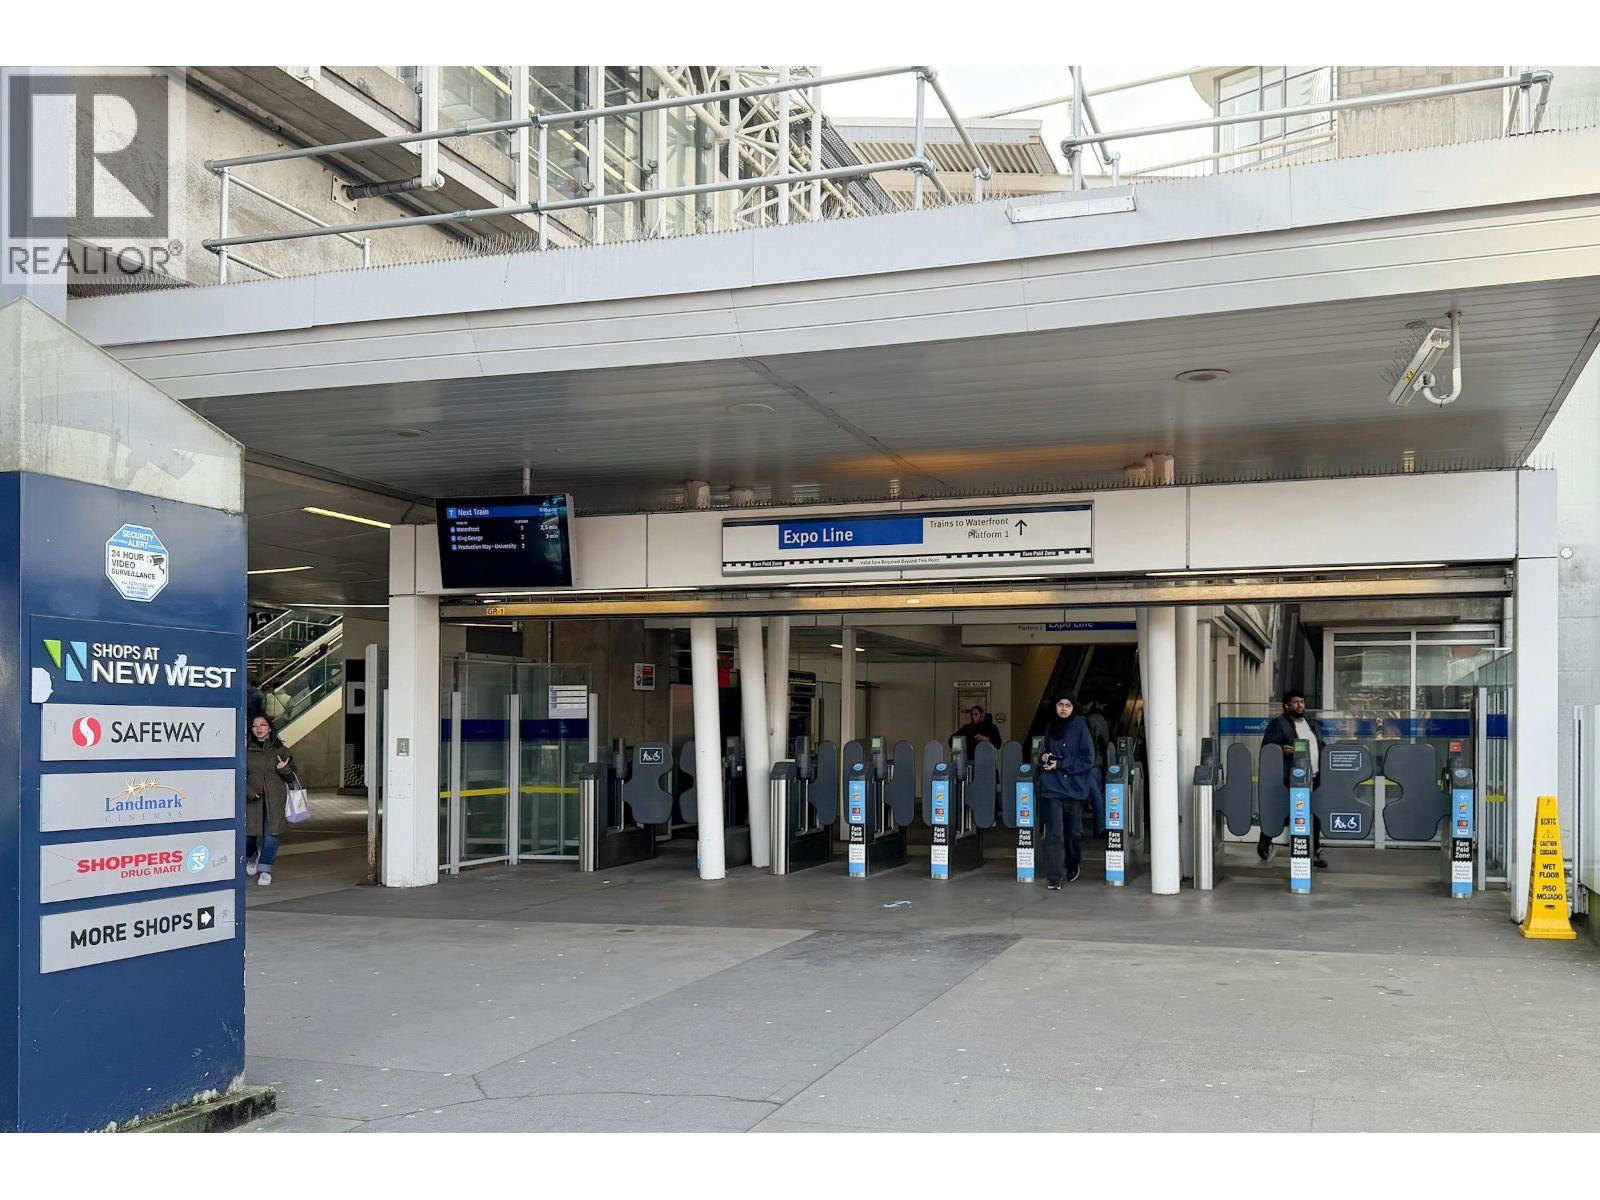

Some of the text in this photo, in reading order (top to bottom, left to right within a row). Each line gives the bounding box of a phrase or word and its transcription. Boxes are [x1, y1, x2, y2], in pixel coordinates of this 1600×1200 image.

[473, 508, 490, 516] Train
[930, 519, 954, 528] Trains
[965, 518, 1009, 526] Waterfront
[122, 530, 154, 542] SECURITY
[784, 528, 854, 546] Expo Line
[968, 531, 1002, 539] Platform
[128, 539, 149, 550] ALERT
[112, 550, 144, 561] 24 HOUR
[112, 559, 136, 569] VIDEO
[112, 568, 156, 580] SURVEILLANCE
[92, 642, 160, 660] SHOPS AT
[91, 661, 237, 689] NEW WEST
[111, 721, 206, 744] SAFEWAY
[105, 794, 183, 812] Landmark
[105, 811, 184, 823] CINEMAS
[76, 850, 183, 874] SHOPPERS
[120, 864, 183, 879] DRUG MART
[70, 912, 193, 950] MORE SHOPS
